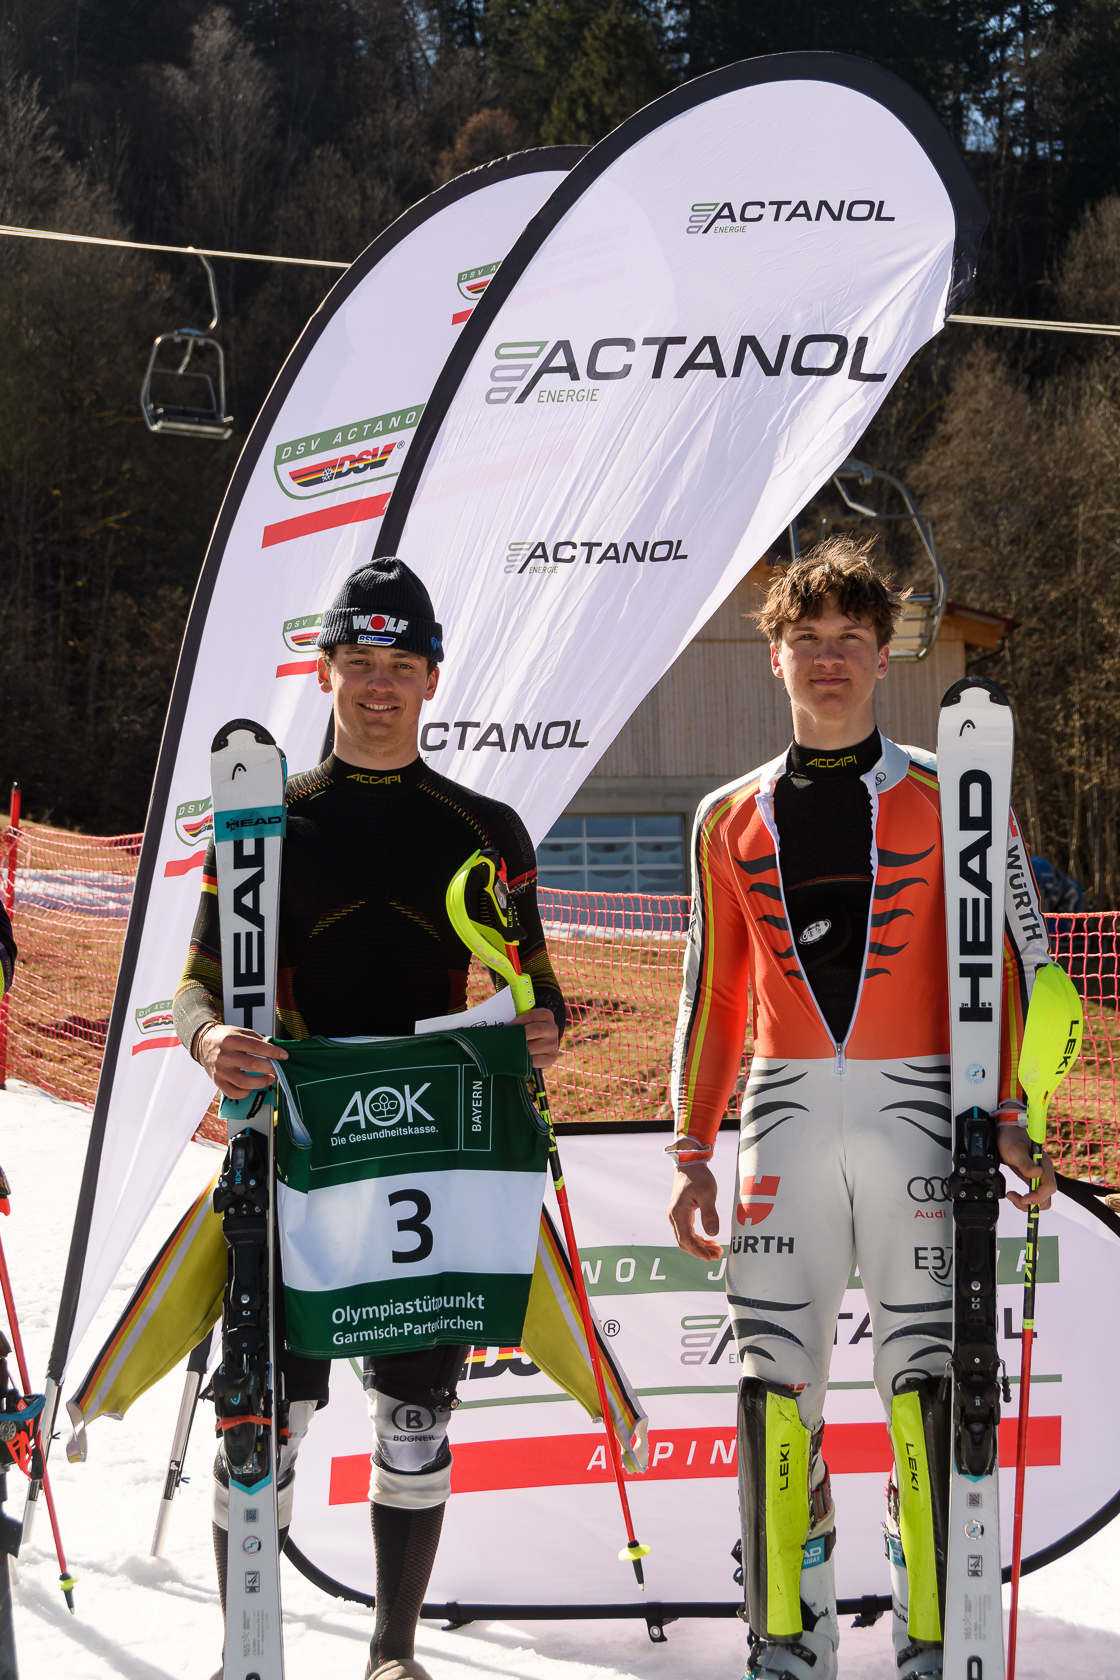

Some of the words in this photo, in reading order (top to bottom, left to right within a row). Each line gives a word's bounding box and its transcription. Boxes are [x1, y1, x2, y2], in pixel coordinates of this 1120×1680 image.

[702, 200, 895, 234] ACTANOL
[461, 268, 484, 281] DSV
[515, 334, 888, 404] ACTANOL
[537, 388, 600, 403] ENERGIE
[281, 439, 321, 460] DSV
[332, 411, 417, 445] ACTANO
[517, 540, 688, 574] ACTANOL
[528, 566, 559, 574] ENERGIE
[286, 618, 308, 630] DSV
[353, 614, 409, 633] WOLF
[420, 719, 590, 752] CTANOL
[806, 755, 857, 768] ACCAPI
[346, 774, 401, 785] ACCAPI
[179, 803, 205, 816] DSV
[226, 816, 282, 829] HEAD
[959, 769, 993, 1022] HEAD
[1007, 845, 1043, 942] WÜRTH
[233, 811, 265, 1038] HEAD
[1055, 1019, 1080, 1076] LEKI
[333, 1082, 435, 1134] AOK
[472, 1080, 483, 1132] BAYERN
[330, 1135, 347, 1147] Die
[348, 1125, 439, 1144] Gesundheitskasse.
[387, 1188, 434, 1264] 3
[914, 1209, 947, 1219] Audi
[731, 1236, 795, 1254] ÜRTH
[392, 1434, 435, 1442] BOGNER
[587, 1440, 737, 1471] APIN
[779, 1443, 791, 1491] LEKI
[905, 1442, 919, 1492] LEKI
[802, 1546, 822, 1558] AD
